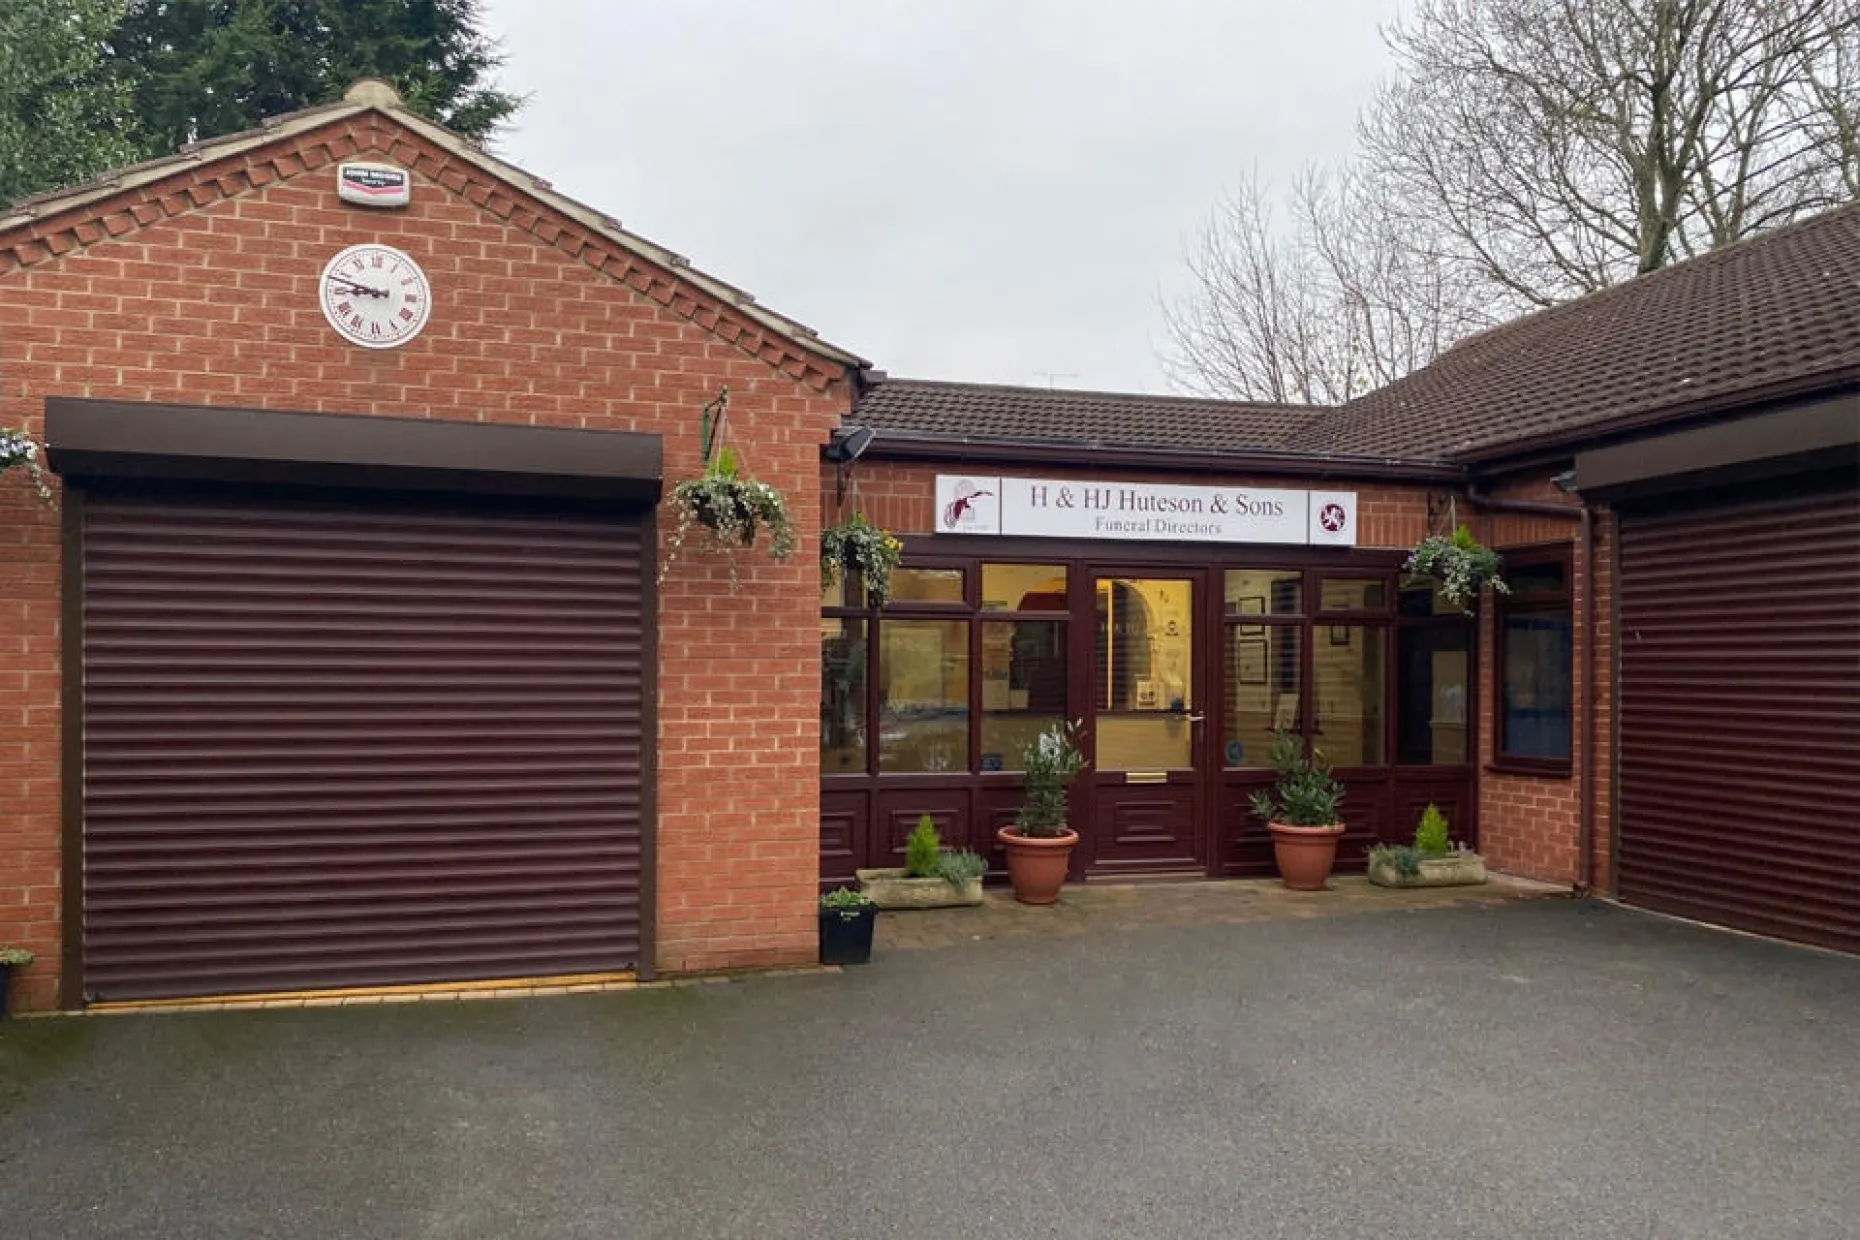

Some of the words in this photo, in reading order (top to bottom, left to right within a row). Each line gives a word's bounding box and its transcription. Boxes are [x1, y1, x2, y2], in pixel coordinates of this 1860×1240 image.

[1030, 485, 1048, 508] H
[1055, 487, 1075, 509] &
[1083, 488, 1111, 511] HJ
[1119, 490, 1204, 514] Huteson
[1210, 494, 1229, 515] &
[1235, 494, 1285, 516] Sons
[1095, 516, 1150, 533] Funeral
[1154, 518, 1223, 535] Directors
